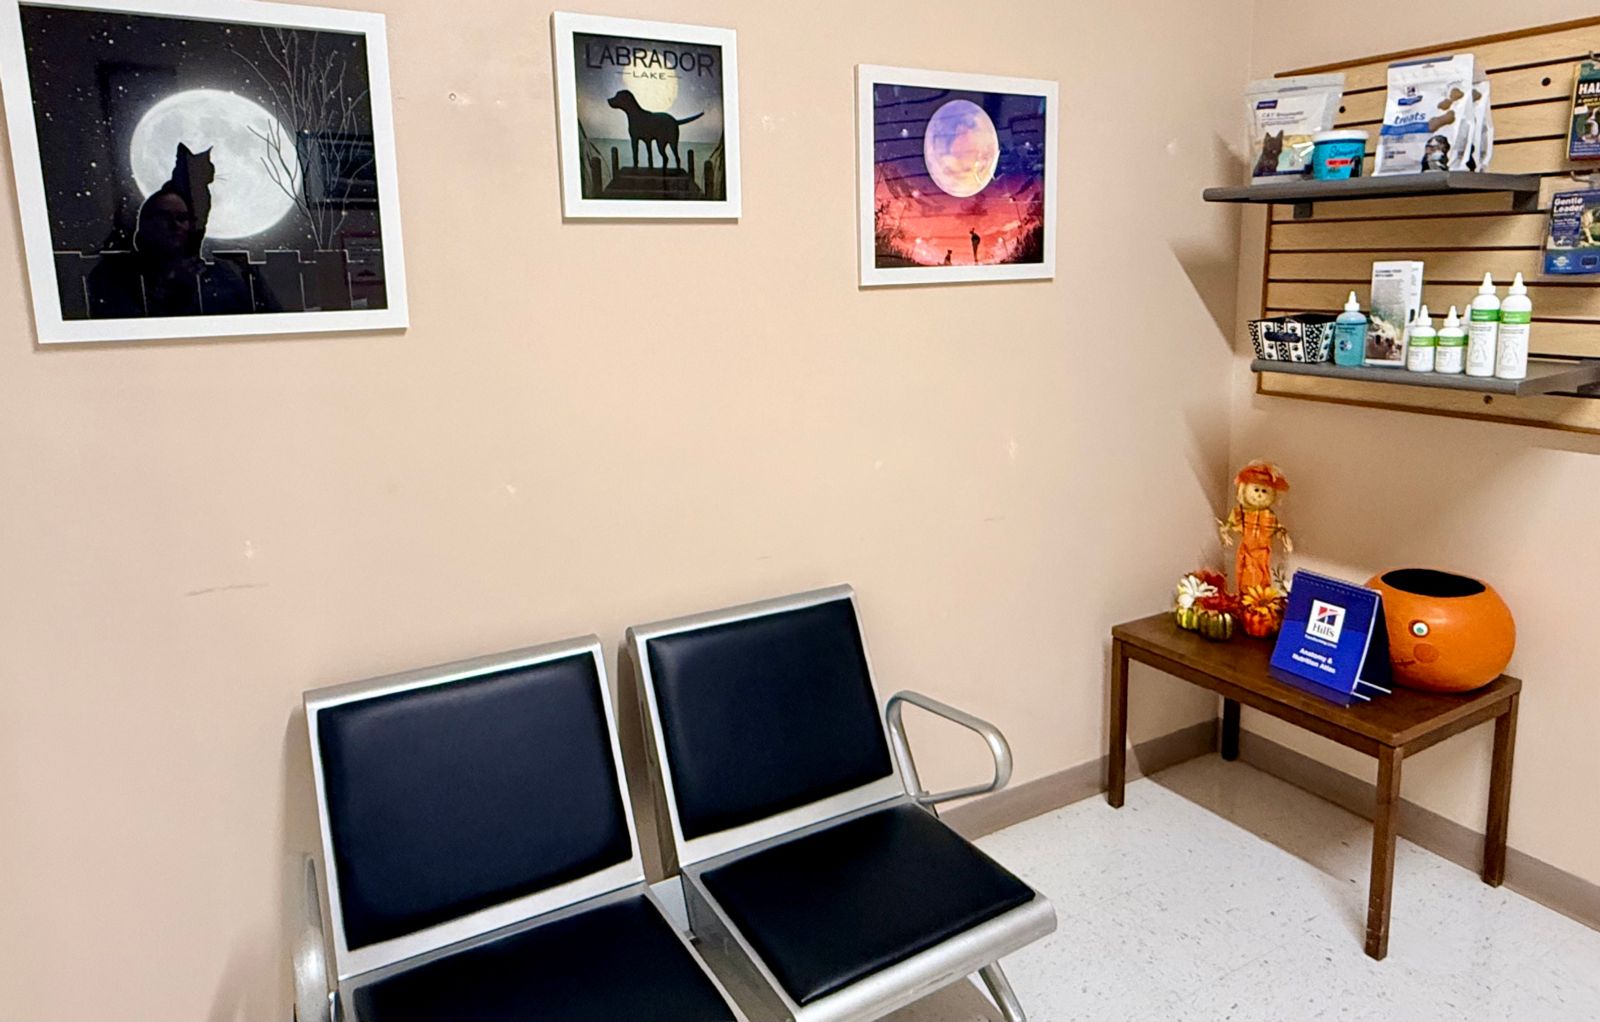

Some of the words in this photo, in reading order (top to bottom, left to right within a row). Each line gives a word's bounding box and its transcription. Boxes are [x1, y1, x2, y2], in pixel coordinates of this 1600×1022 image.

[585, 43, 714, 77] LABRADOR
[633, 71, 667, 80] LAKE
[1394, 113, 1426, 124] treats
[1554, 197, 1583, 205] Gentle
